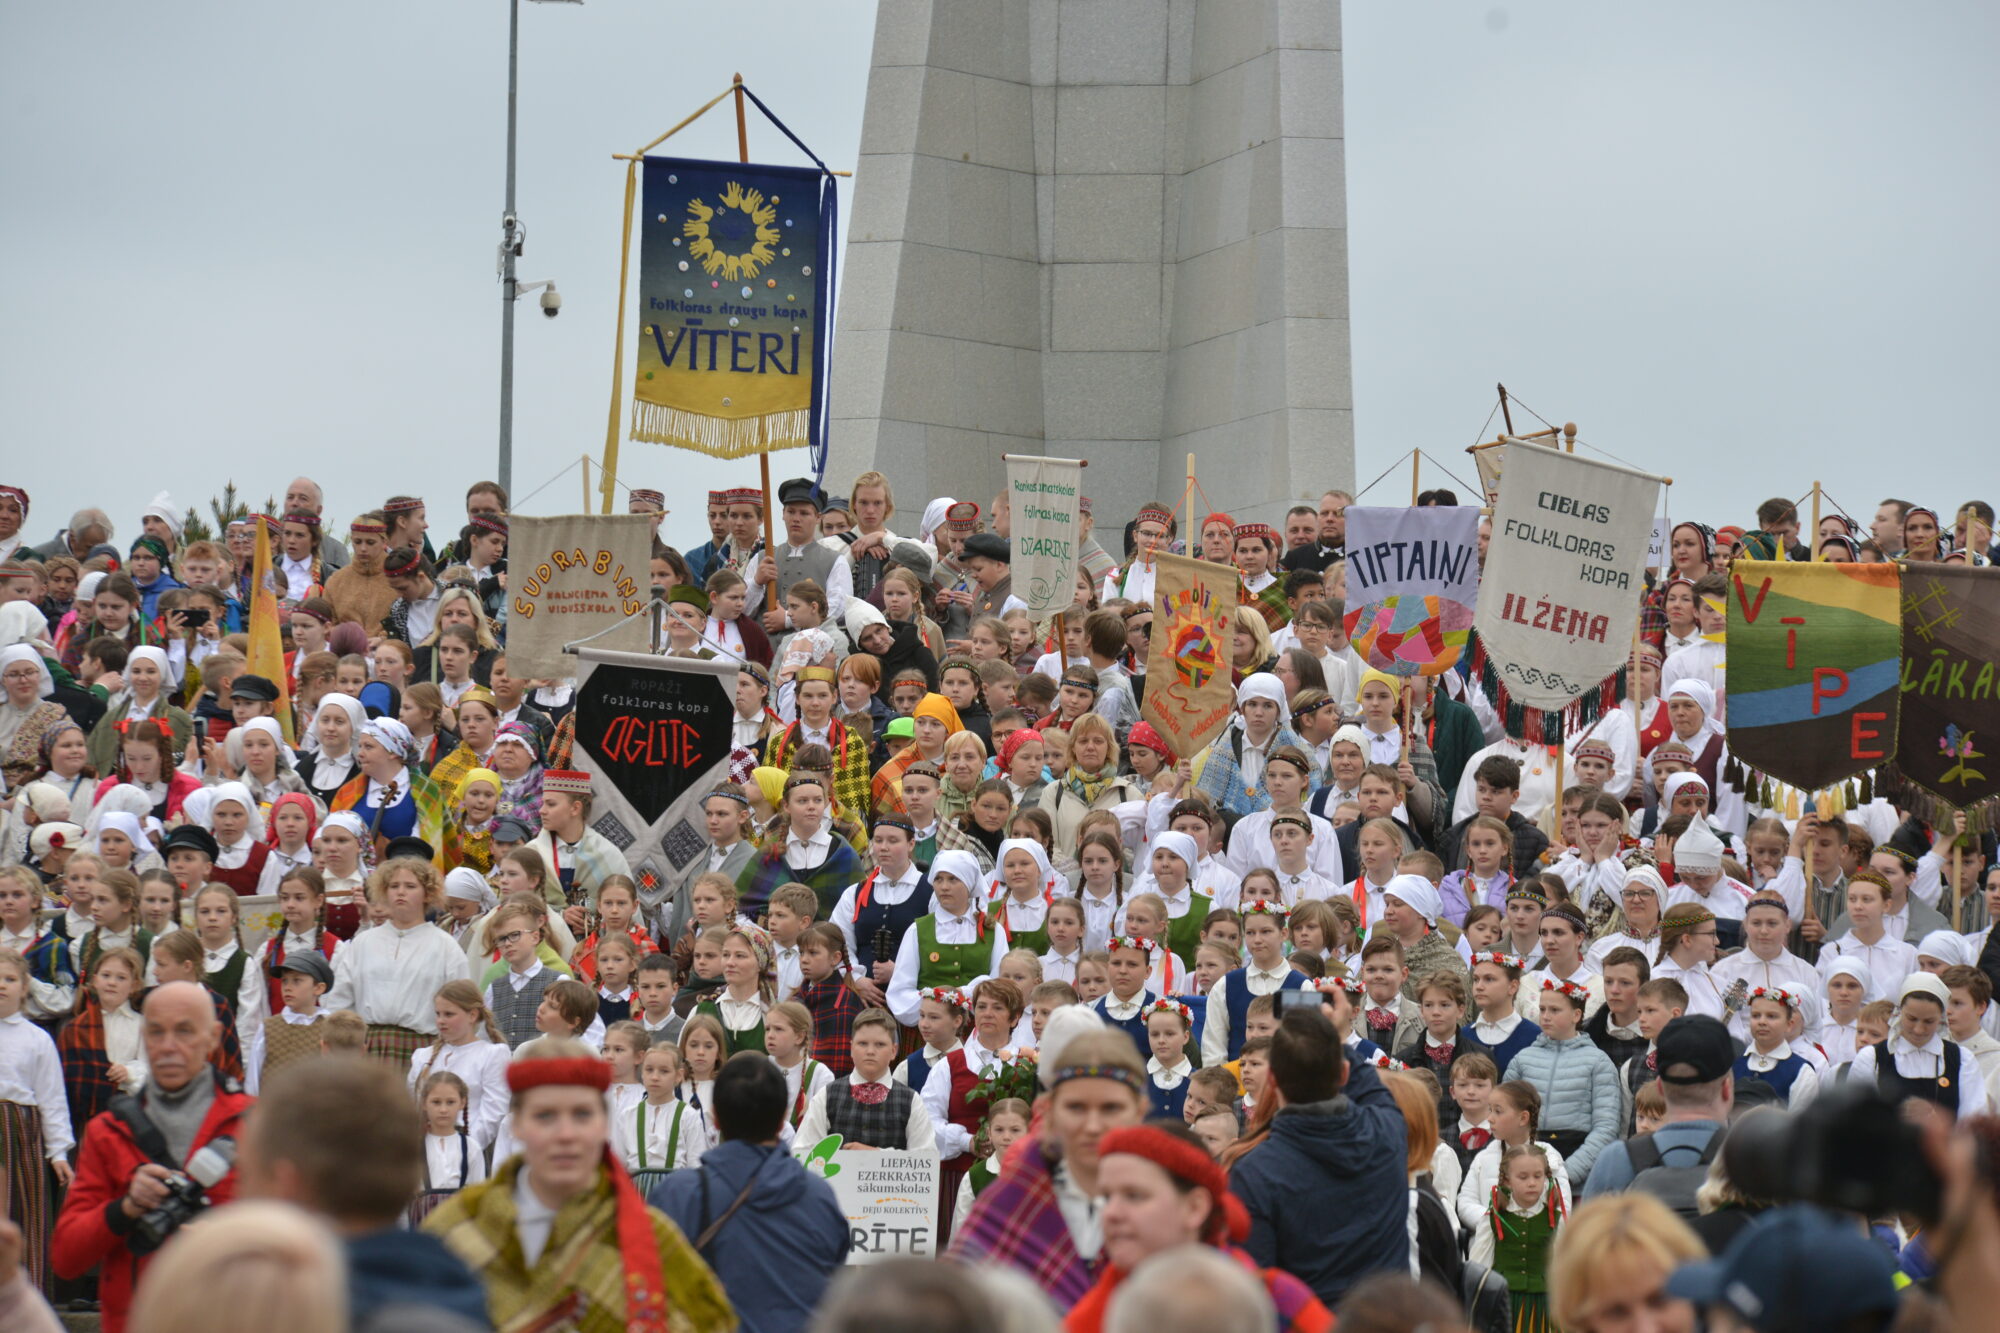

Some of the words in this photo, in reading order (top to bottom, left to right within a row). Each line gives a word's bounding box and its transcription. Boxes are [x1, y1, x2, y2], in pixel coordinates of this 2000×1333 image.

[650, 297, 713, 314] Folkloras
[719, 301, 767, 319] draugu
[773, 304, 808, 321] kopa
[651, 318, 800, 376] VĪTERI
[1537, 491, 1610, 524] CIBLAS
[1504, 519, 1615, 562] FOLKLORAS
[1347, 540, 1473, 589] TIPTAIŅI
[1580, 564, 1629, 590] KOPA
[1501, 592, 1609, 644] ILŽEŅA
[1733, 574, 1887, 759] VĪPE
[602, 694, 673, 711] folkloras
[678, 701, 710, 714] kopa
[602, 715, 702, 769] OGLĪTE
[858, 1171, 932, 1182] EZERKRASTA
[881, 1156, 932, 1170] LIEPĀJAS
[857, 1183, 930, 1193] sākumskolas
[862, 1206, 882, 1215] DEJU
[884, 1205, 929, 1214] KOLEKTĪVS
